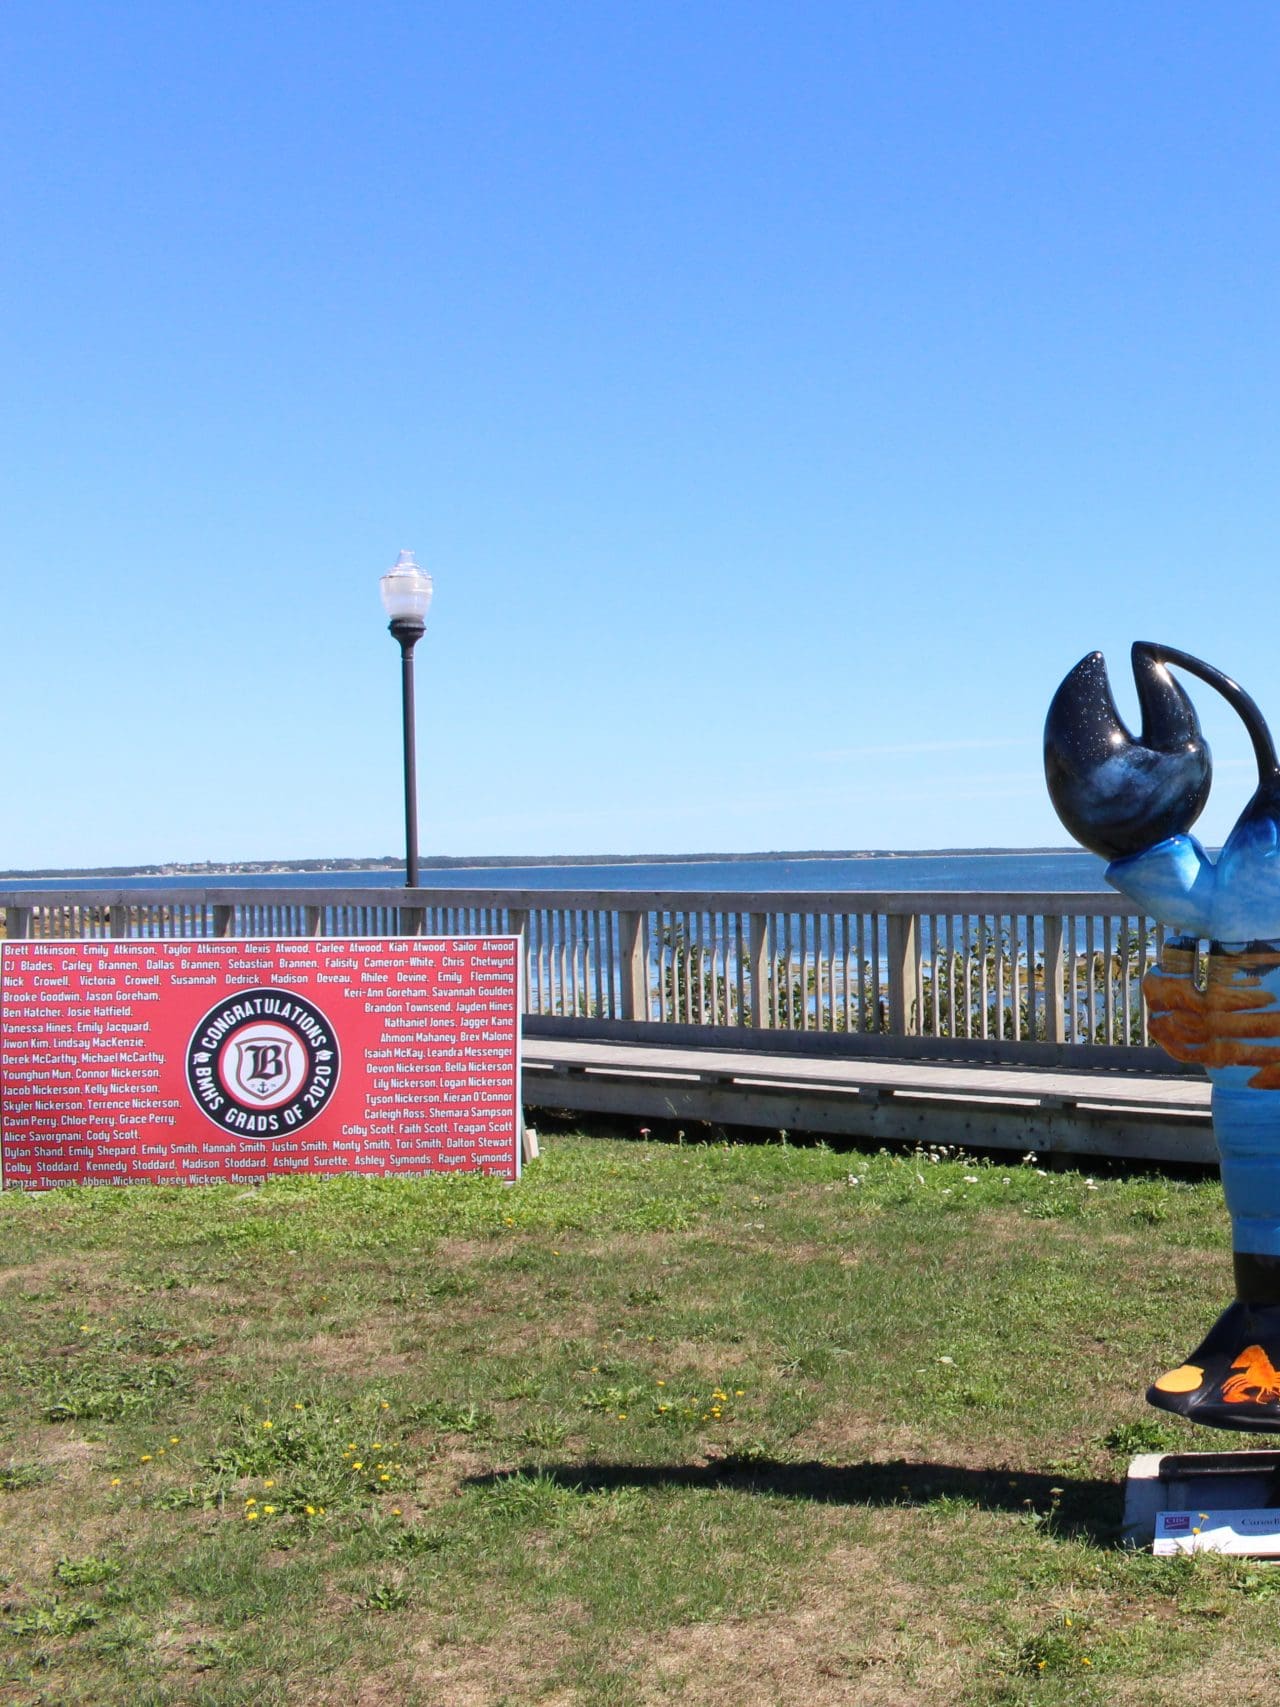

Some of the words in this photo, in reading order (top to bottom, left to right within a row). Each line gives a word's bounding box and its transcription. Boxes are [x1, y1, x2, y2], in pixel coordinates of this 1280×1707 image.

[4, 945, 28, 955] Brett
[82, 944, 108, 957] Emily
[162, 943, 192, 957] Taylor
[388, 941, 408, 952] Kiah
[452, 941, 477, 951] Sailor
[482, 940, 514, 951] Atwood
[4, 960, 14, 970] CJ
[61, 960, 92, 973] Carley
[146, 959, 174, 969] Dallas
[228, 958, 273, 968] Sebastian
[441, 956, 464, 966] Chris
[4, 976, 24, 986] Nick
[80, 975, 115, 985] Victoria
[171, 974, 216, 984] Susannah
[271, 973, 307, 983] Madison
[438, 971, 462, 985] Emily
[470, 971, 513, 984] Flemming
[3, 991, 37, 1002] Brooke
[85, 990, 112, 1001] Jason
[344, 987, 383, 998] Keri-Ann
[431, 986, 475, 996] Savannah
[478, 985, 513, 996] Goulden
[3, 1007, 21, 1017] Ben
[68, 1006, 90, 1016] Josie
[364, 1002, 402, 1012] Brandon
[455, 1001, 487, 1014] Jayden
[488, 1000, 513, 1011] Hines
[2, 1022, 43, 1032] Vanessa
[76, 1021, 103, 1035] Emily
[202, 998, 327, 1049] CONGRATULATIONS
[384, 1016, 427, 1027] Nathaniel
[491, 1015, 513, 1026] Kane
[481, 1030, 513, 1041] Malone
[2, 1038, 28, 1048] Jiwon
[53, 1037, 90, 1051] Lindsay
[2, 1053, 29, 1063] Derek
[81, 1052, 117, 1062] Michael
[364, 1047, 392, 1058] Isaiah
[426, 1046, 463, 1057] Leandra
[464, 1045, 512, 1059] Messenger
[245, 1045, 283, 1081] B
[366, 1062, 394, 1073] Devon
[444, 1061, 467, 1072] Bella
[467, 1061, 512, 1071] Nickerson
[75, 1067, 109, 1078] Connor
[4, 1084, 30, 1094] Jacob
[84, 1083, 107, 1096] Kelly
[373, 1078, 389, 1091] Lily
[439, 1077, 466, 1090] Logan
[467, 1076, 513, 1087] Nickerson
[3, 1100, 32, 1113] Skyler
[87, 1098, 130, 1109] Terrence
[195, 1066, 224, 1110] BMHS
[224, 1107, 279, 1131] GRADS
[283, 1103, 303, 1125] OF
[365, 1093, 393, 1107] Tyson
[61, 1114, 86, 1124] Chloe
[119, 1113, 146, 1123] Grace
[364, 1108, 401, 1122] Carleigh
[470, 1106, 512, 1120] Sampson
[86, 1129, 110, 1142] Cody
[341, 1124, 367, 1138] Colby
[399, 1123, 421, 1133] Faith
[453, 1121, 486, 1135] Teagan
[488, 1121, 512, 1132] Scott
[4, 1146, 30, 1160] Dylan
[68, 1145, 93, 1158] Emily
[141, 1143, 167, 1157] Emily
[202, 1142, 236, 1152] Hannah
[271, 1140, 297, 1151] Justin
[332, 1139, 360, 1153] Monty
[396, 1138, 412, 1149] Tori
[446, 1137, 475, 1148] Dalton
[478, 1136, 512, 1147] Stewart
[4, 1161, 31, 1175] Colby
[86, 1159, 127, 1173] Kennedy
[182, 1157, 219, 1168] Madison
[354, 1154, 385, 1168] Ashley
[470, 1151, 512, 1165] Symonds
